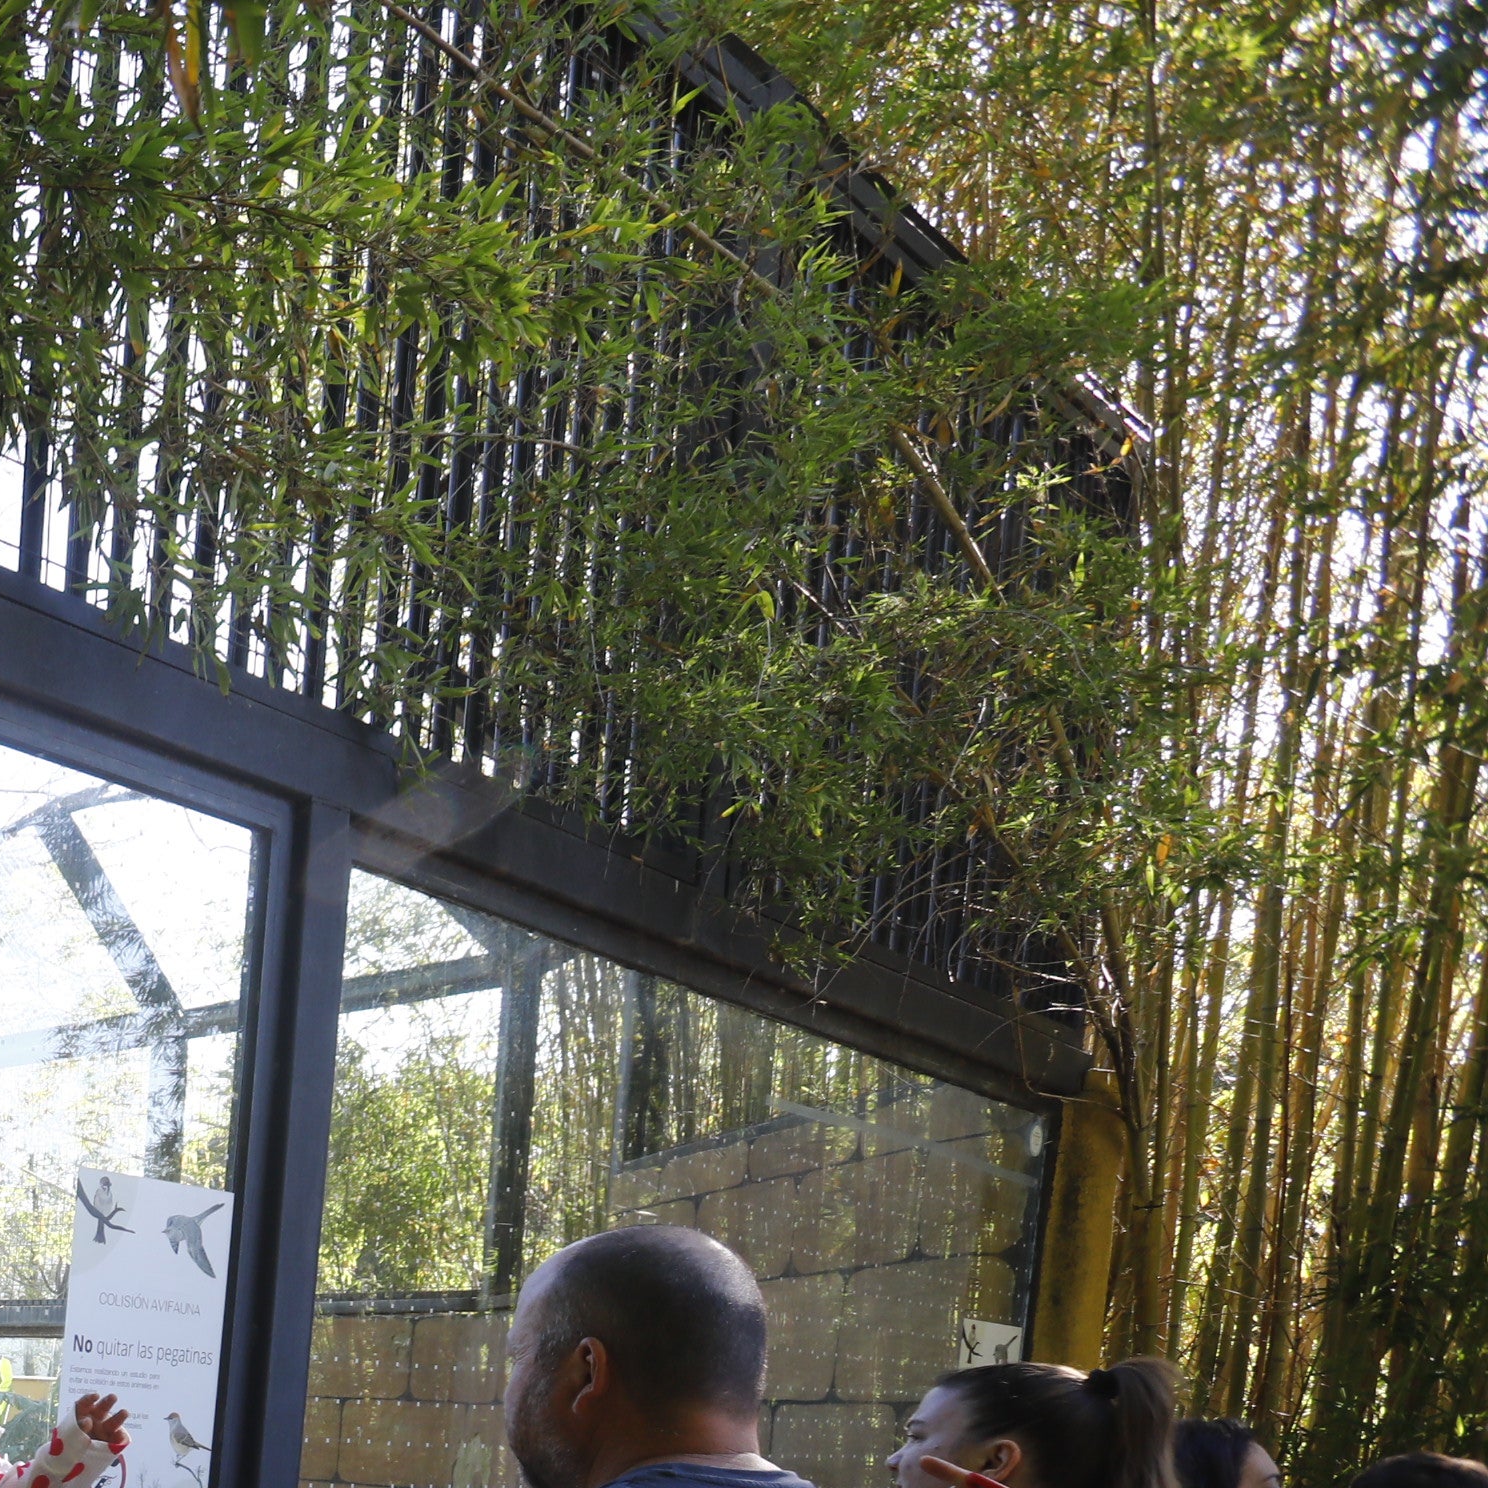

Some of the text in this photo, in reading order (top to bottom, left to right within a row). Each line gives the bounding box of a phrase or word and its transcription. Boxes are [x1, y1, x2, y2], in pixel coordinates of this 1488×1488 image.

[99, 1291, 201, 1316] COLISIÓN AVIFAUNA
[73, 1334, 214, 1367] No quitar las pegatinas
